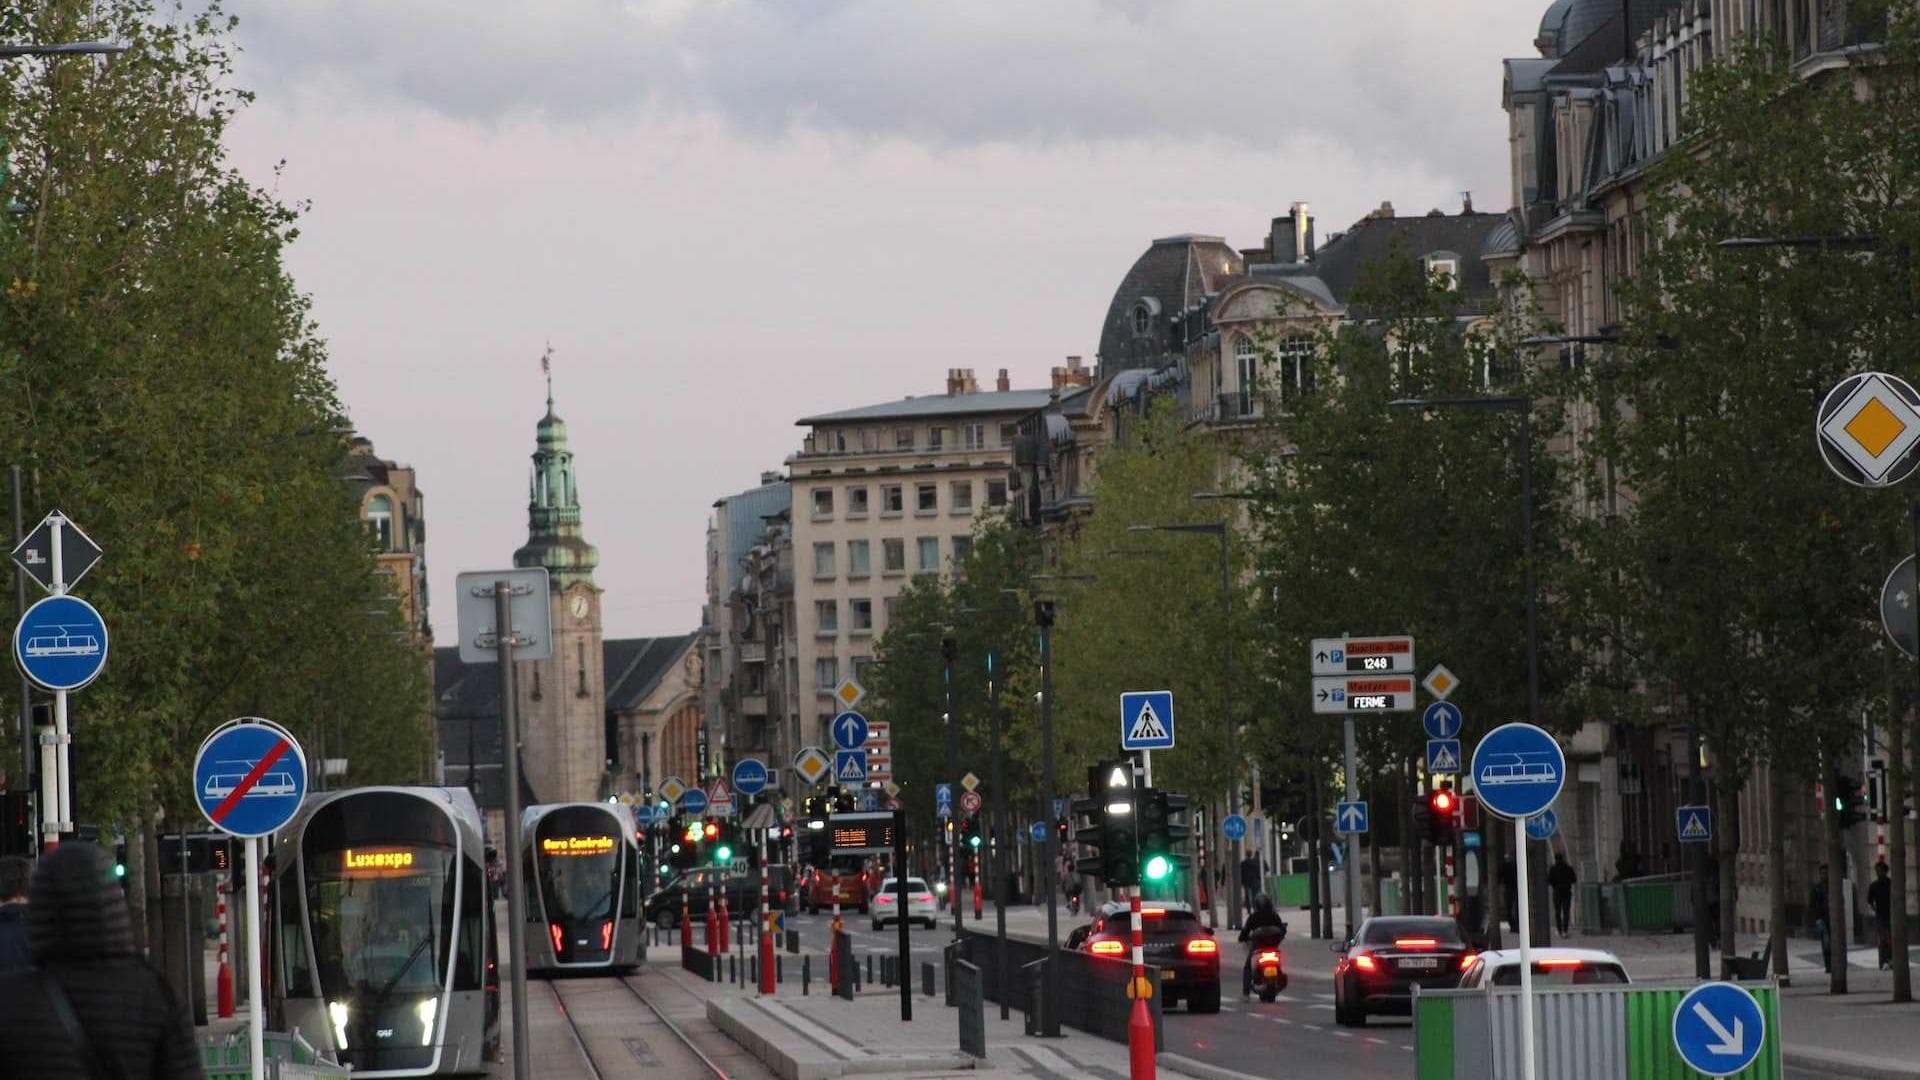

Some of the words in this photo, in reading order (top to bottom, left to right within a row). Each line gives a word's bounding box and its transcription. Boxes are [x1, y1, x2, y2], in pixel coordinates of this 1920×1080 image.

[1364, 658, 1387, 669] 1248
[1354, 696, 1386, 708] FERME
[346, 849, 413, 869] Luxexpo
[732, 861, 746, 872] 40
